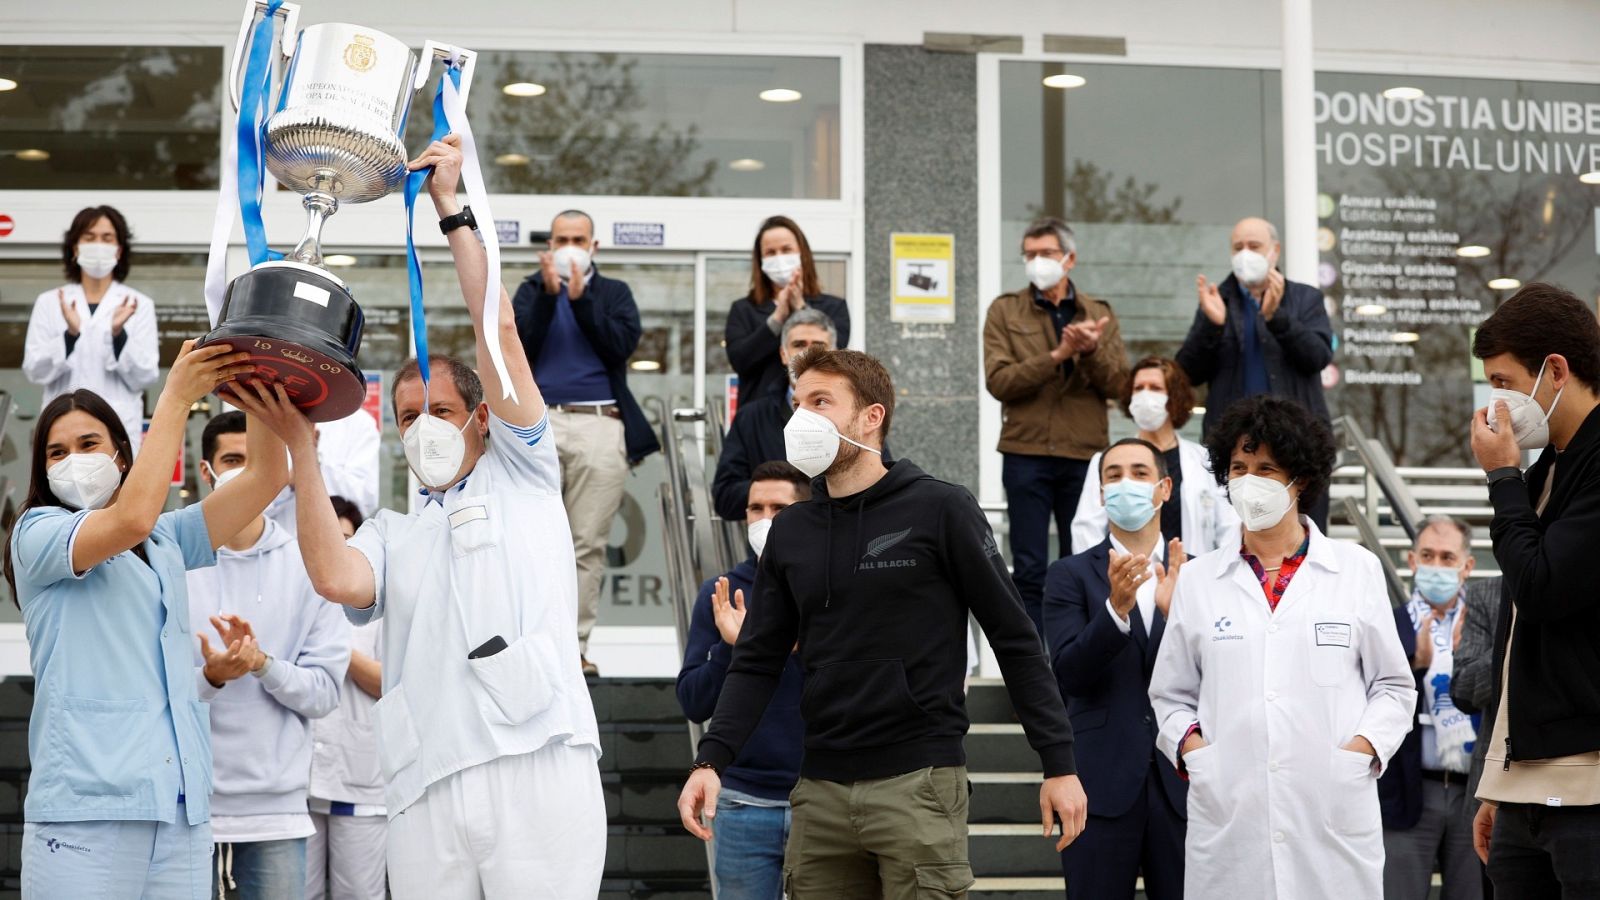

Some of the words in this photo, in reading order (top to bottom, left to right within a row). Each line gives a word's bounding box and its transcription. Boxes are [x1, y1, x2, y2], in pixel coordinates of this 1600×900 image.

[1314, 91, 1496, 131] DONOSTIA
[1315, 131, 1493, 171] HOSPITAL
[1339, 193, 1382, 208] Amara
[1340, 208, 1391, 222] Edificio
[1393, 209, 1436, 224] Amara
[1341, 241, 1392, 256] Edificio
[859, 561, 875, 570] ALL
[877, 558, 917, 569] BLACKS
